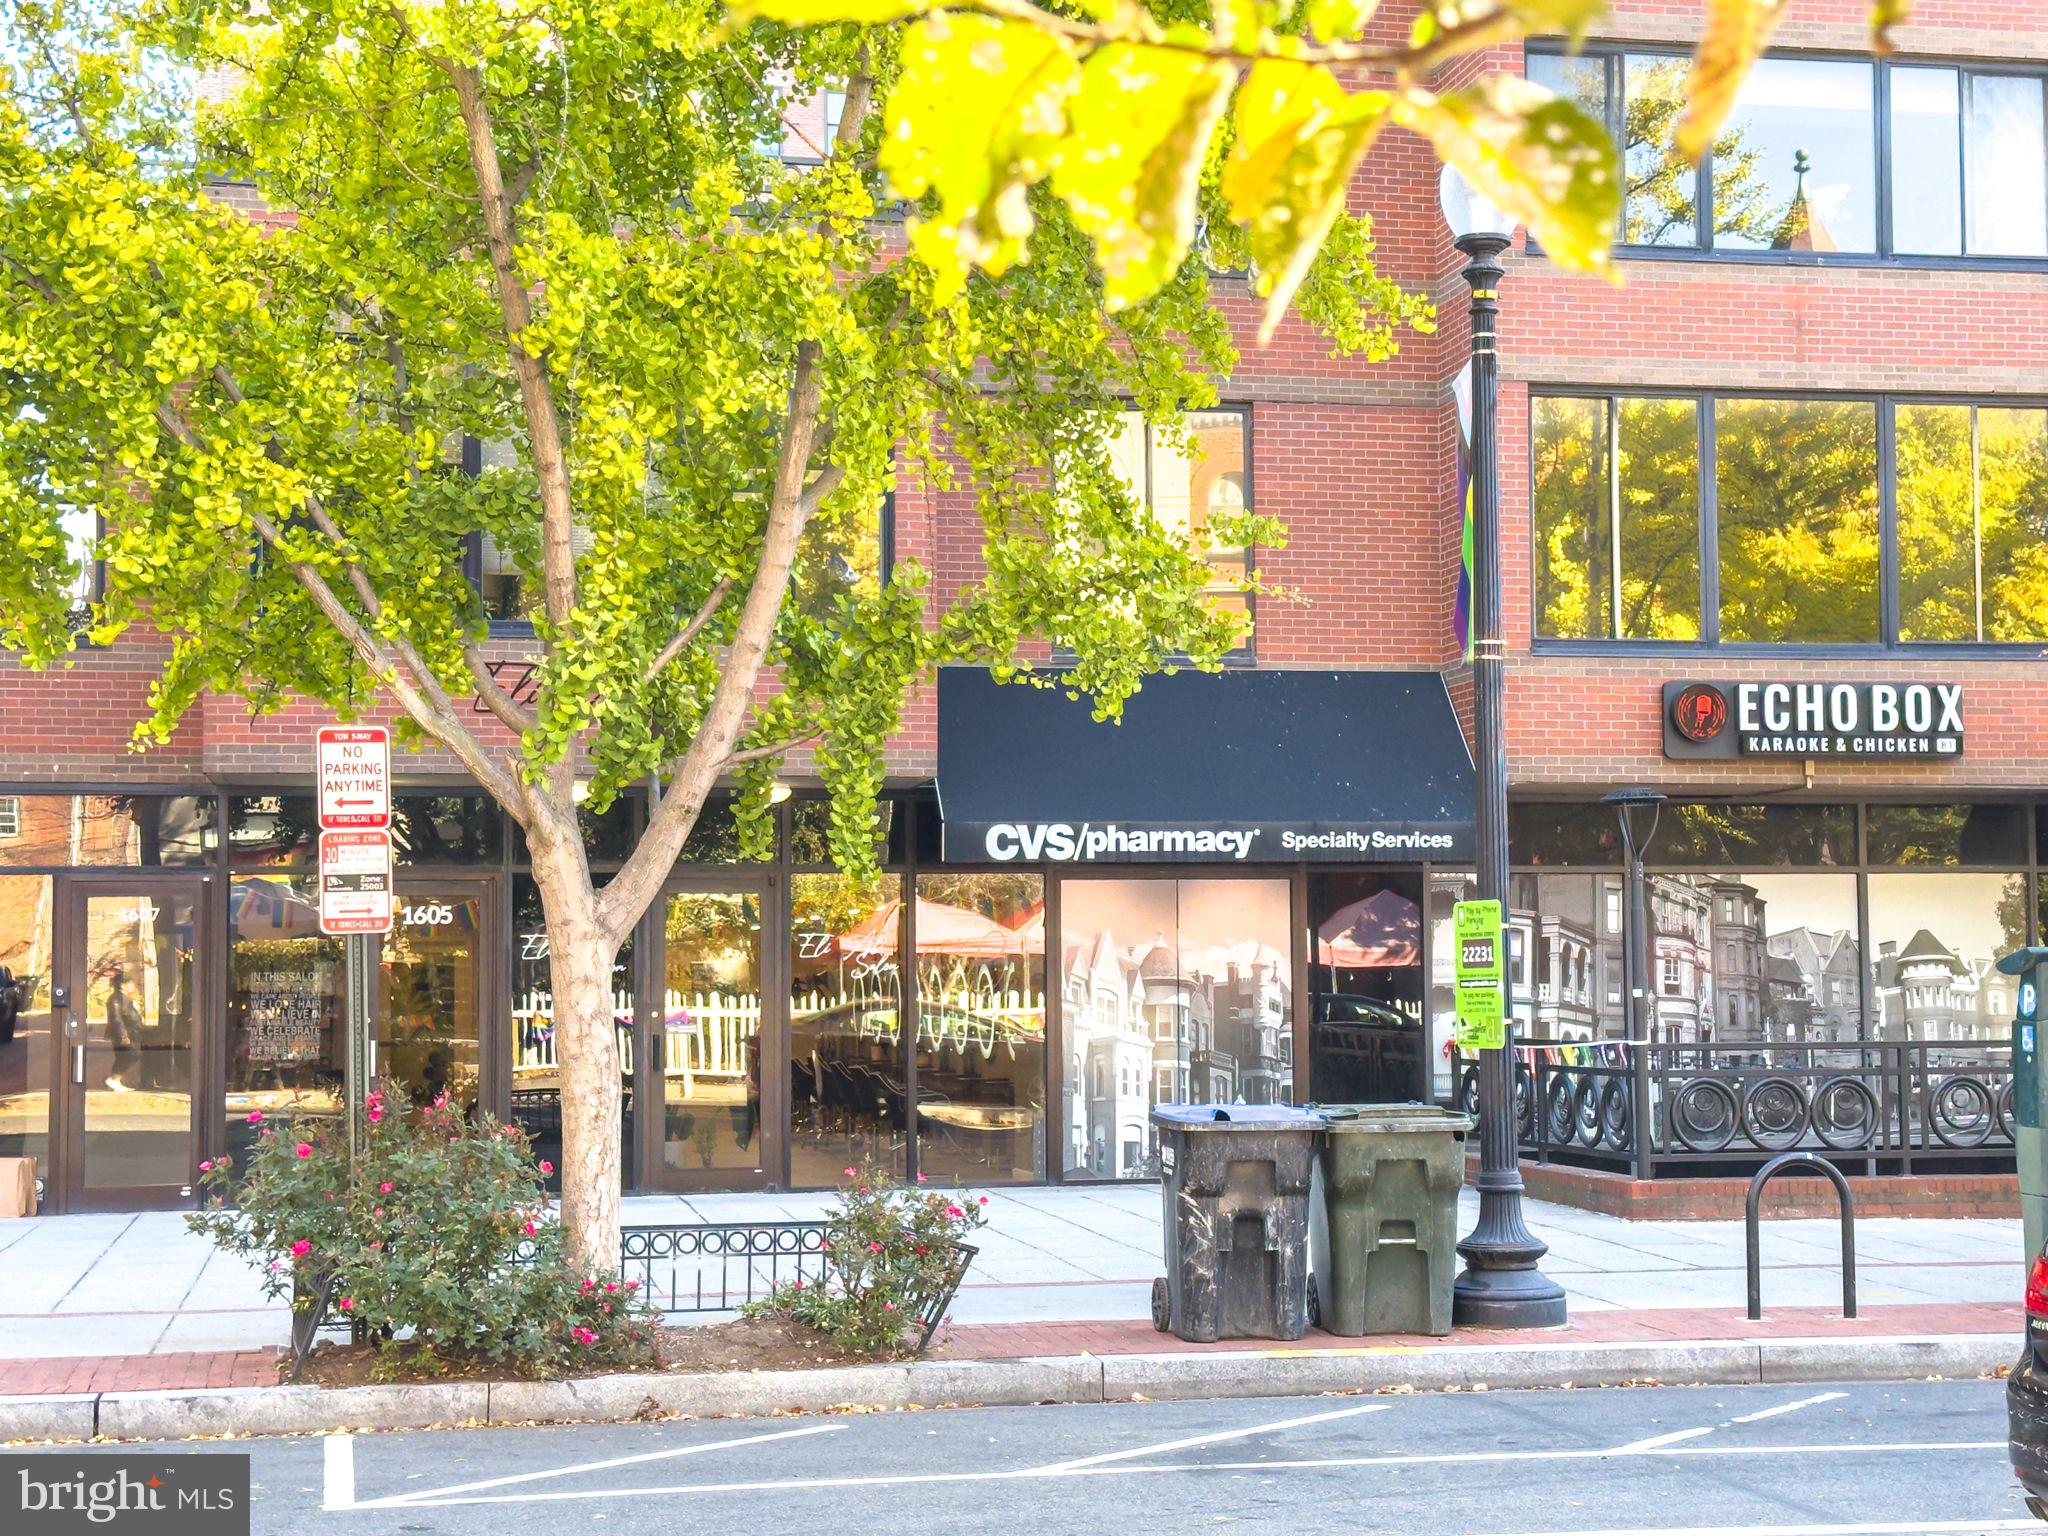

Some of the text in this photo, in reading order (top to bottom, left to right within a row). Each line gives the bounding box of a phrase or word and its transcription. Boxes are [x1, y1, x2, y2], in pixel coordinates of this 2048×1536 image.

[1738, 683, 1965, 732] ECHO BOX
[334, 733, 349, 741] TOW
[1750, 737, 1829, 752] KARAOKE
[1836, 737, 1847, 752] &
[1853, 737, 1929, 753] CHICKEN
[343, 746, 363, 758] NO
[325, 763, 383, 775] PARKING
[324, 780, 384, 792] ANYTIME
[328, 834, 382, 843] LOADING ZONE
[985, 823, 1254, 861] CVS/pharmacy
[1282, 831, 1453, 851] Specialty Services
[325, 847, 338, 863] 30
[360, 875, 384, 883] Zone:
[402, 905, 454, 925] 1605
[1466, 916, 1484, 926] Parking
[798, 933, 835, 959] Eli
[1462, 946, 1494, 963] 22231
[851, 952, 900, 980] Salon
[250, 971, 321, 982] IN THIS SALON
[250, 1000, 266, 1009] WE
[298, 1000, 322, 1009] HAIR
[250, 1026, 321, 1036] WE CELEBRATE
[249, 1046, 262, 1055] WE
[300, 1046, 321, 1055] THAT
